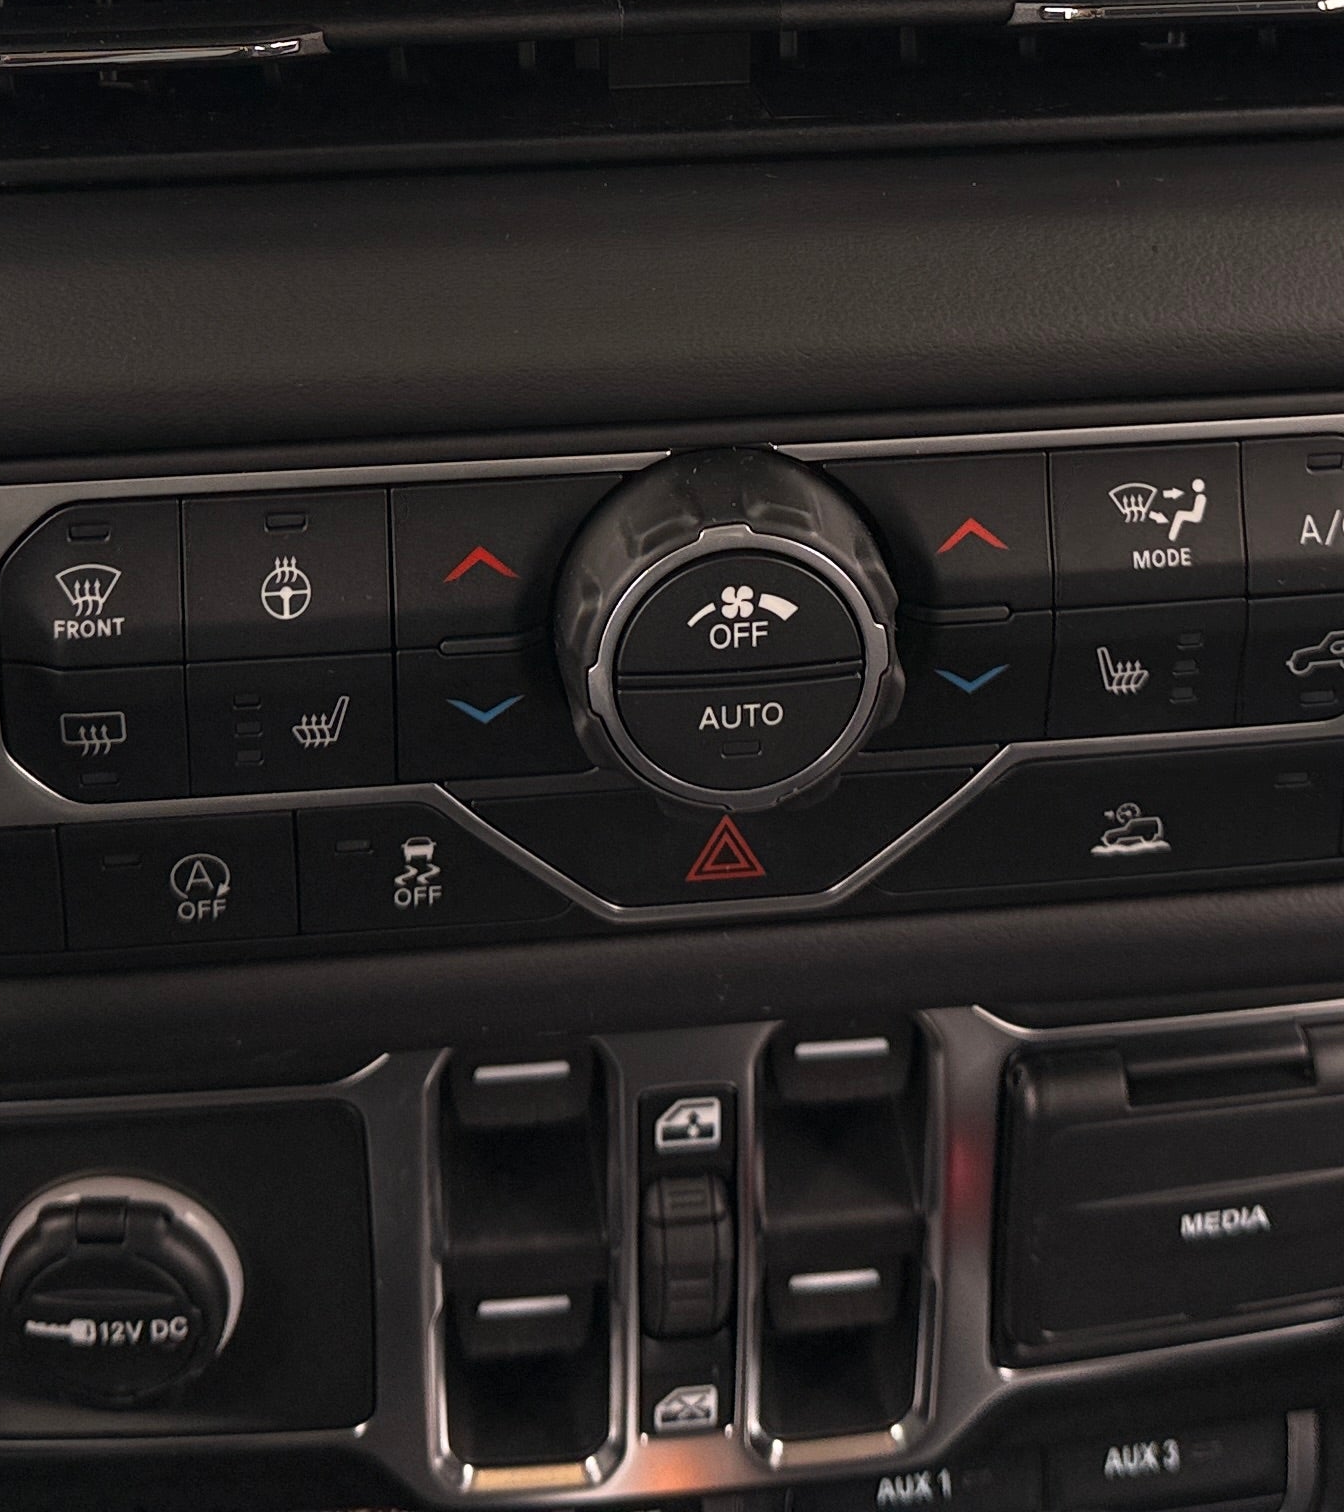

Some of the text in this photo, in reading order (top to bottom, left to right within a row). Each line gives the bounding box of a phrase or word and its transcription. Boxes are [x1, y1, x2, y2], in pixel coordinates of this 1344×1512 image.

[1132, 547, 1193, 570] MODE
[53, 617, 125, 640] FRONT
[708, 620, 769, 651] OFF
[698, 701, 784, 731] AUTO
[177, 897, 227, 921] OFF
[393, 886, 443, 909] OFF
[1180, 1204, 1272, 1241] MEDIA
[99, 1316, 189, 1343] 12V DC
[1103, 1438, 1181, 1479] AUX 3
[876, 1467, 952, 1507] AUX 1
